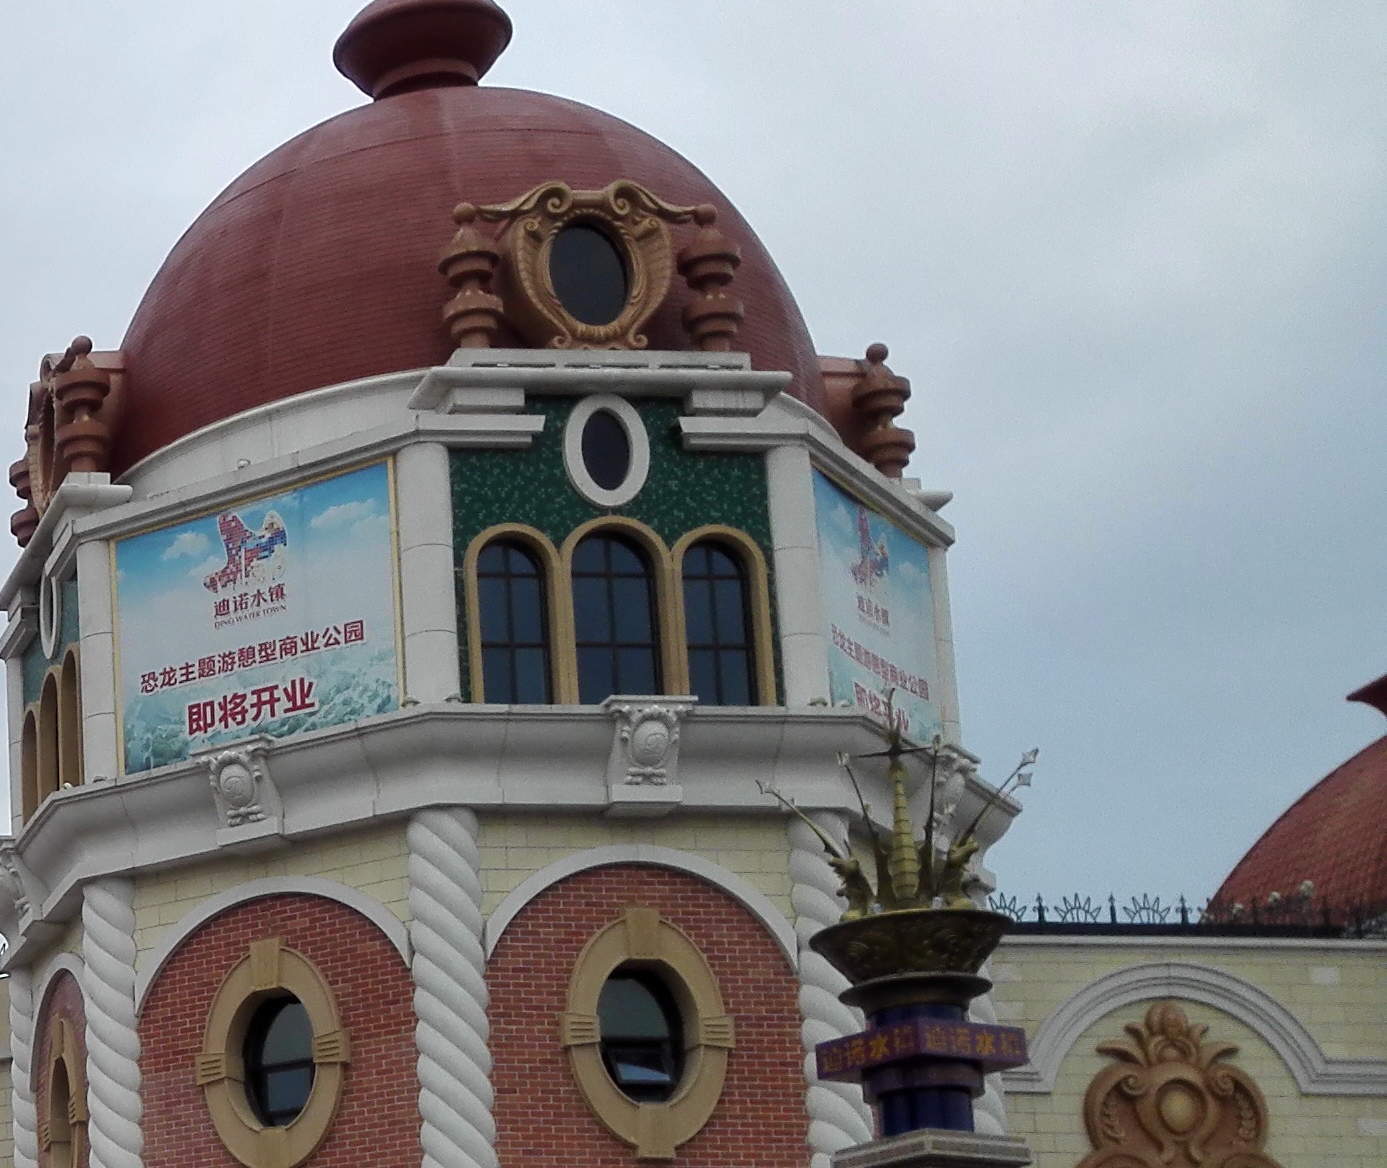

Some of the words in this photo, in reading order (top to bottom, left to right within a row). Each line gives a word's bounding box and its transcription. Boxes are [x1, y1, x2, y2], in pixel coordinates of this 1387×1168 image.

[214, 583, 286, 619] 迪诺水镇
[141, 620, 364, 693] 恐龙主题游憩型商业公园
[188, 678, 316, 735] 即将开业
